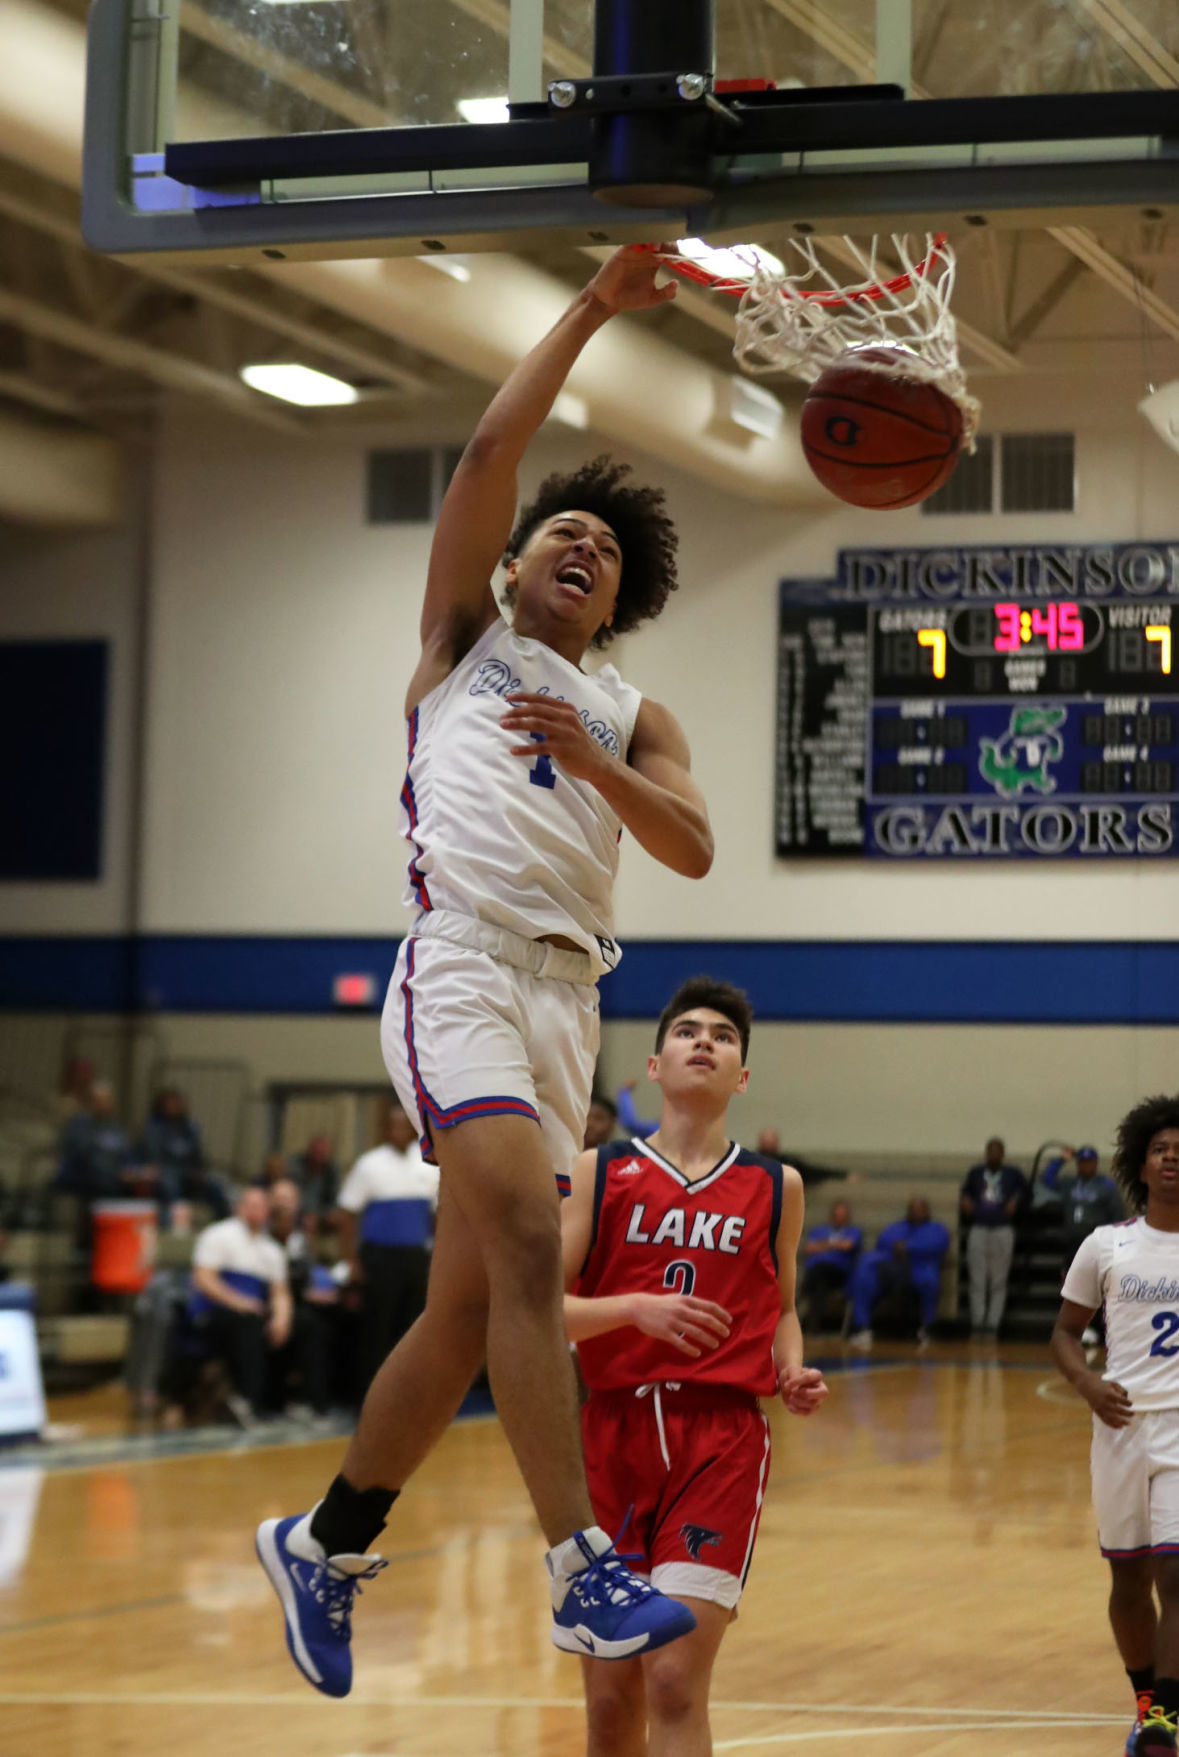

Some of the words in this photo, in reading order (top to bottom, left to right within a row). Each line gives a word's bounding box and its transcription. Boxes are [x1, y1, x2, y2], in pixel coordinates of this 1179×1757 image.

[844, 548, 1179, 599] DICKINSO
[994, 602, 1085, 651] 3:45
[1109, 605, 1172, 628] VISITOR
[917, 629, 946, 679] 7
[1145, 625, 1171, 674] 7
[874, 806, 1172, 853] GATORS
[625, 1203, 747, 1255] LAKE
[1150, 1311, 1179, 1357] 2
